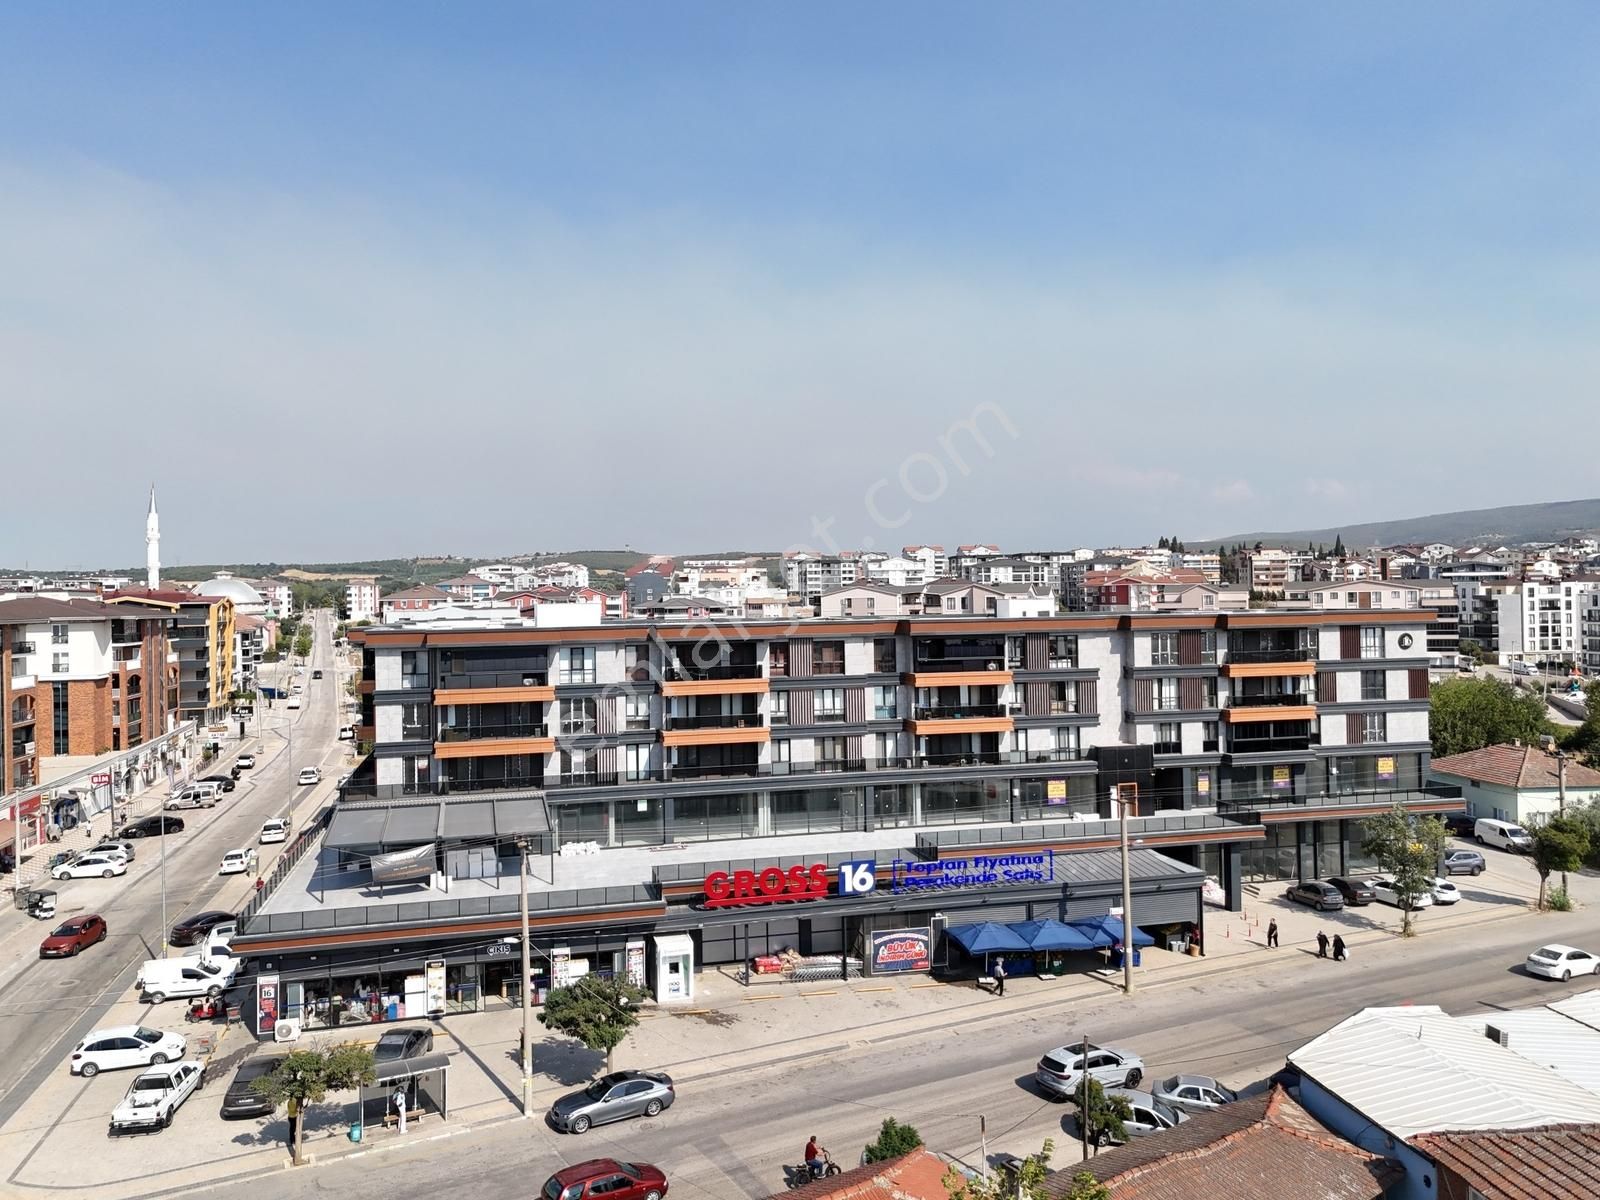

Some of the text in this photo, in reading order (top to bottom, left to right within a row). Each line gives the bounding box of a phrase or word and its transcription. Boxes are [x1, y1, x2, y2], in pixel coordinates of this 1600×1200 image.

[904, 853, 1044, 875] Toptan Fiyatına
[704, 862, 875, 900] GROSS 16
[903, 870, 998, 888] Perakende
[486, 944, 511, 957] ÇIKIŞ
[262, 989, 273, 997] 16
